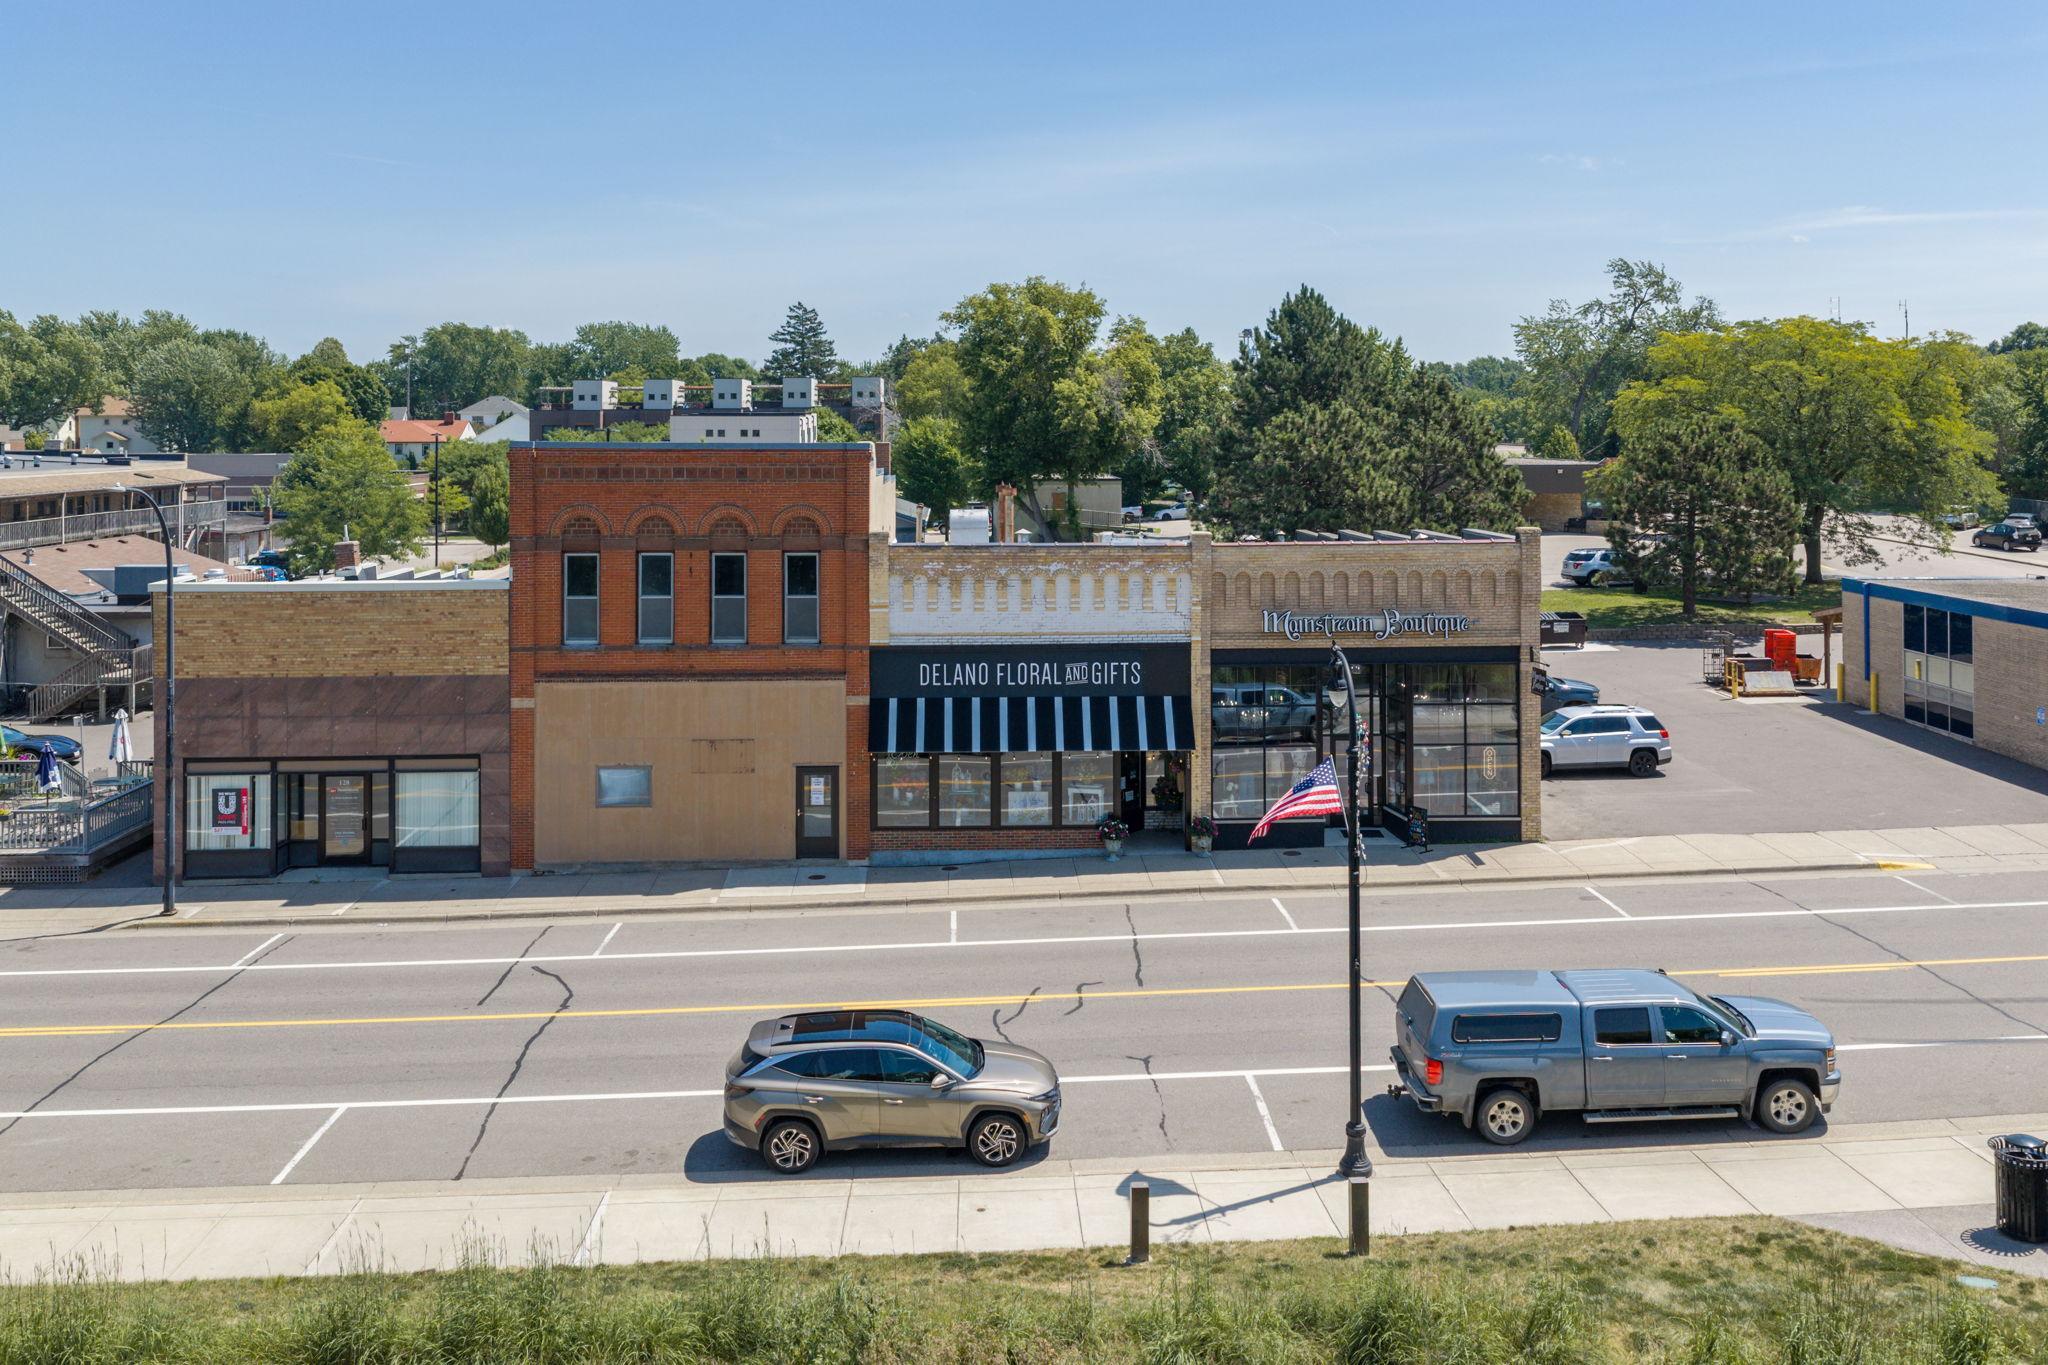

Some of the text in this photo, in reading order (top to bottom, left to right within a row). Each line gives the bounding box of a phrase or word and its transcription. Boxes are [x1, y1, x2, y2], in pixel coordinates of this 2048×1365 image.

[1262, 609, 1470, 641] Mainstream Boutique
[920, 662, 1141, 686] DELANO FLORAL AND GIFTS
[1486, 749, 1494, 777] OPEN
